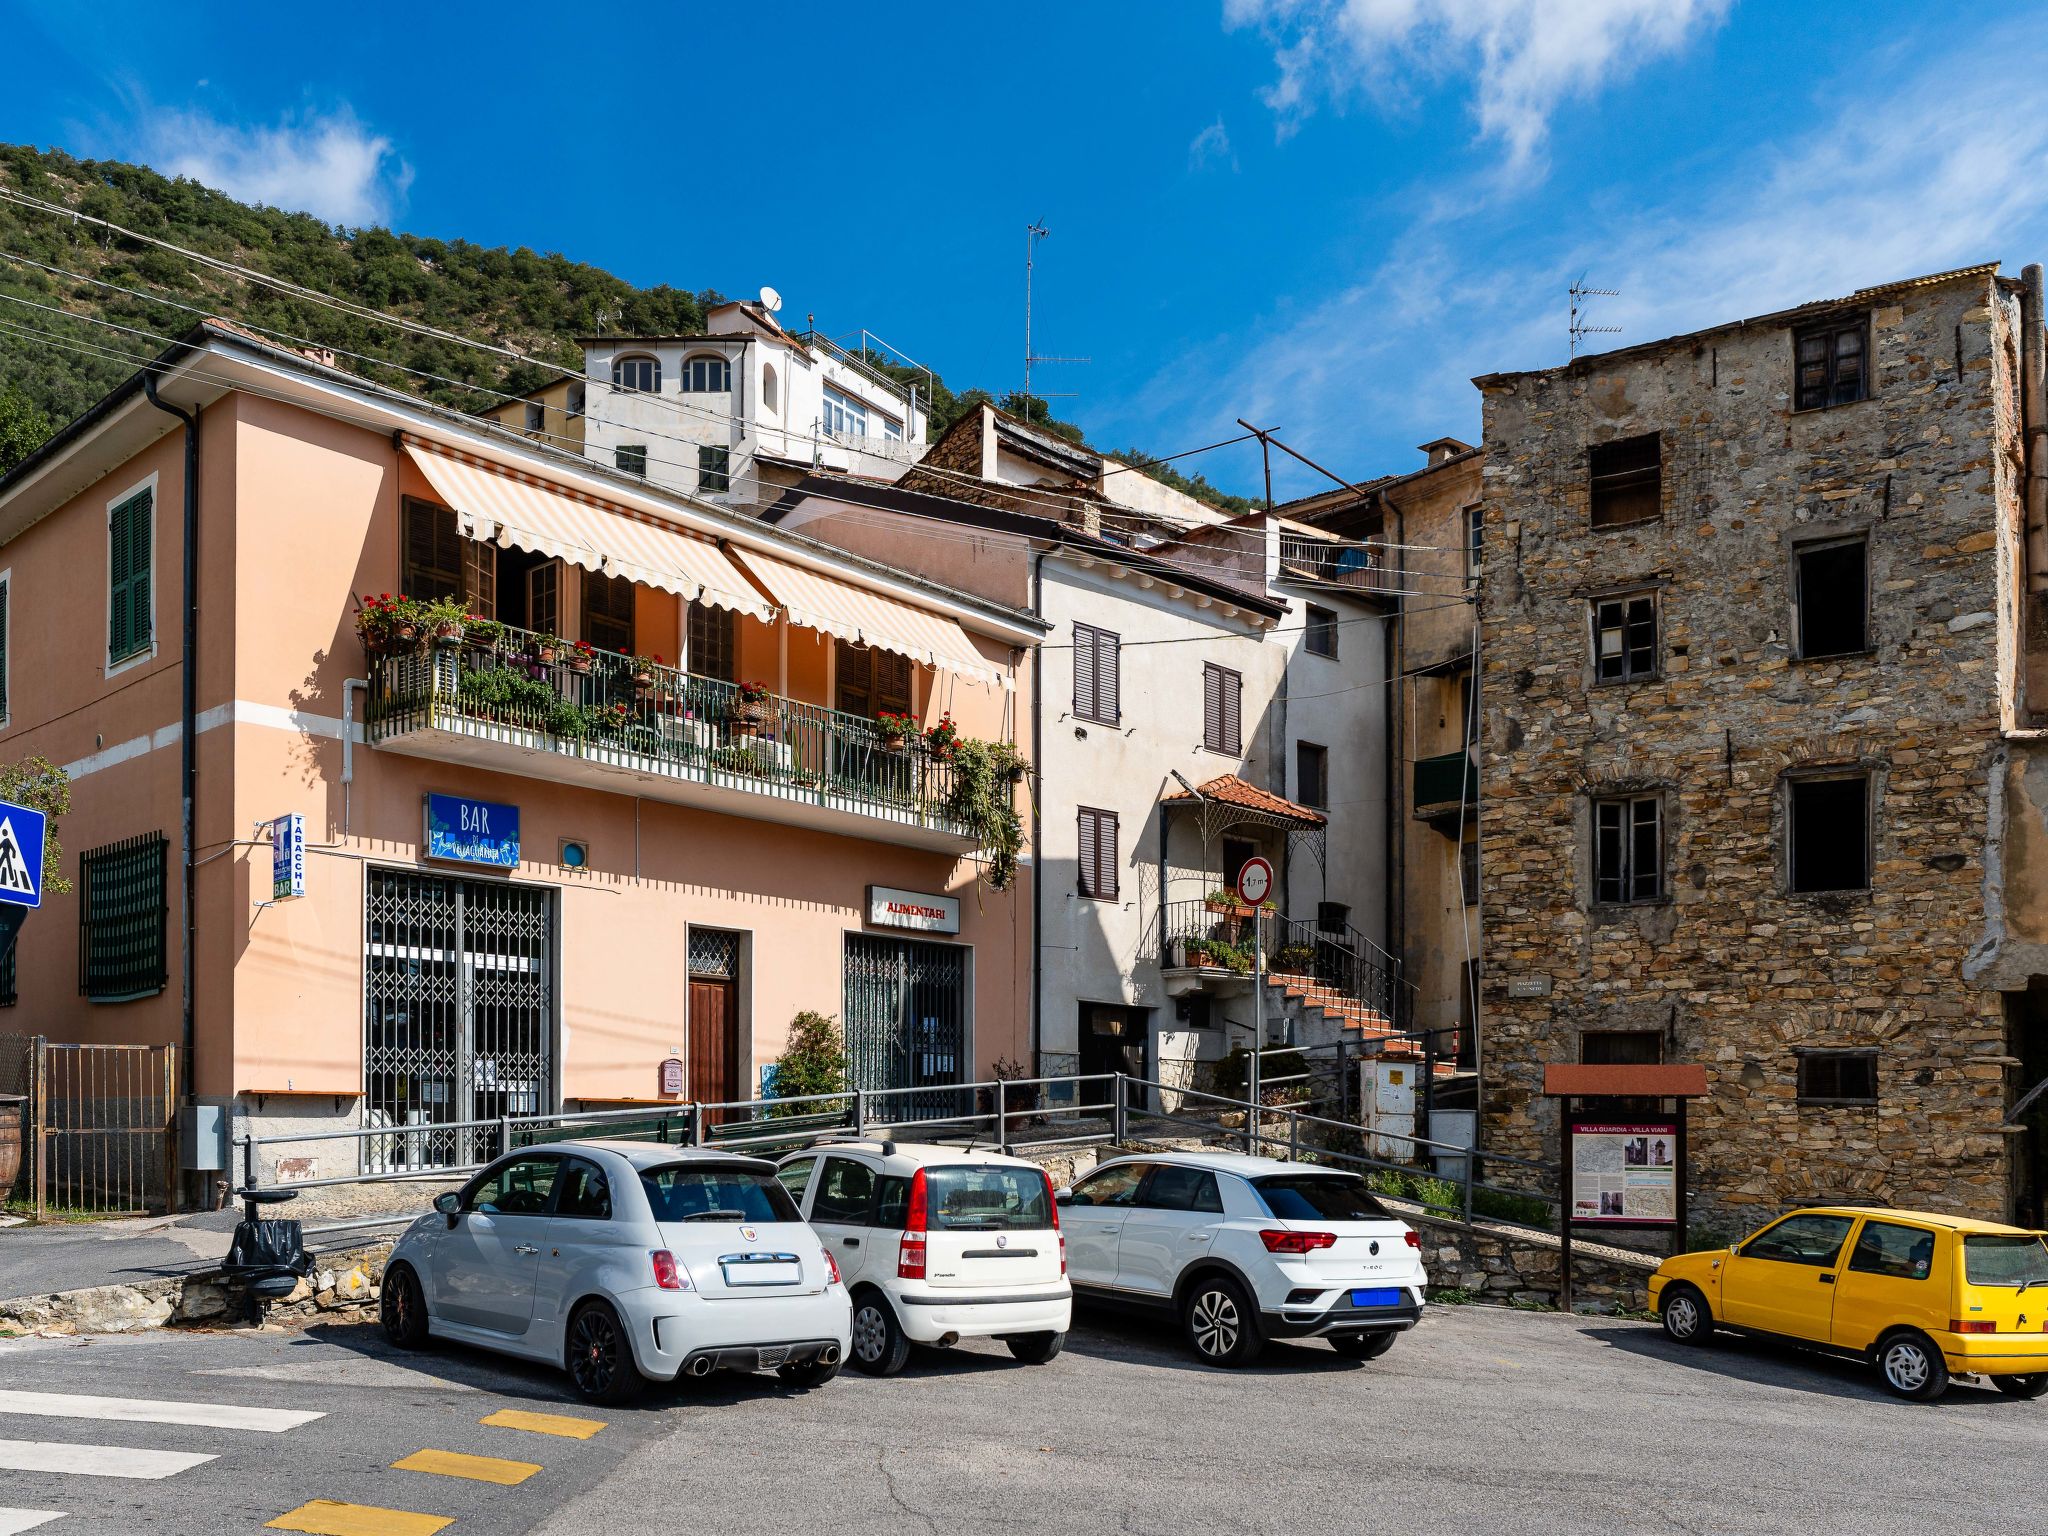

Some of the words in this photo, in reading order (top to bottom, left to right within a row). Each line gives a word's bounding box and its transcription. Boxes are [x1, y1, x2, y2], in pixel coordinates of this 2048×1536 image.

[461, 804, 490, 834] BAR
[274, 881, 290, 896] BAR
[886, 902, 945, 919] ALIMENTARI
